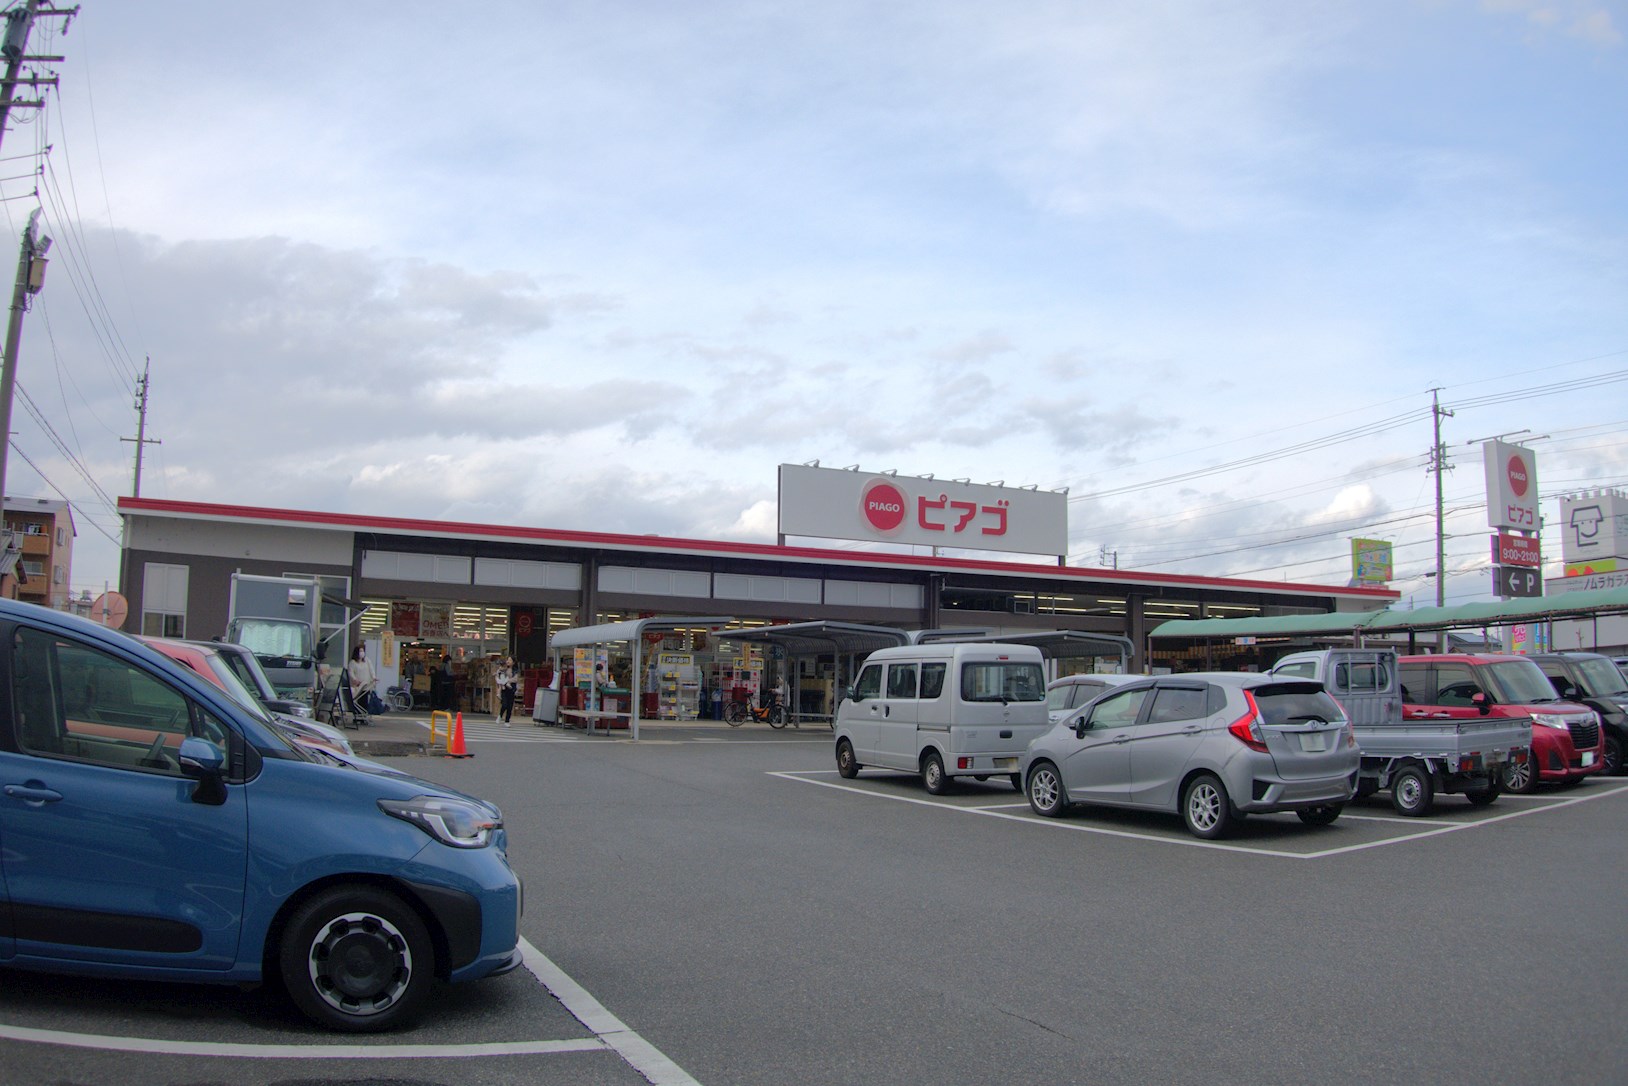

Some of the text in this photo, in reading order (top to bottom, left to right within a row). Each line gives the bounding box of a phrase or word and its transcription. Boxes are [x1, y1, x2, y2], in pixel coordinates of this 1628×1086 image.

[1510, 471, 1526, 482] PIAGO
[869, 501, 900, 513] PIAGO
[917, 494, 1010, 536] ピアゴ
[1508, 503, 1533, 525] ピアゴ
[1526, 573, 1534, 592] P
